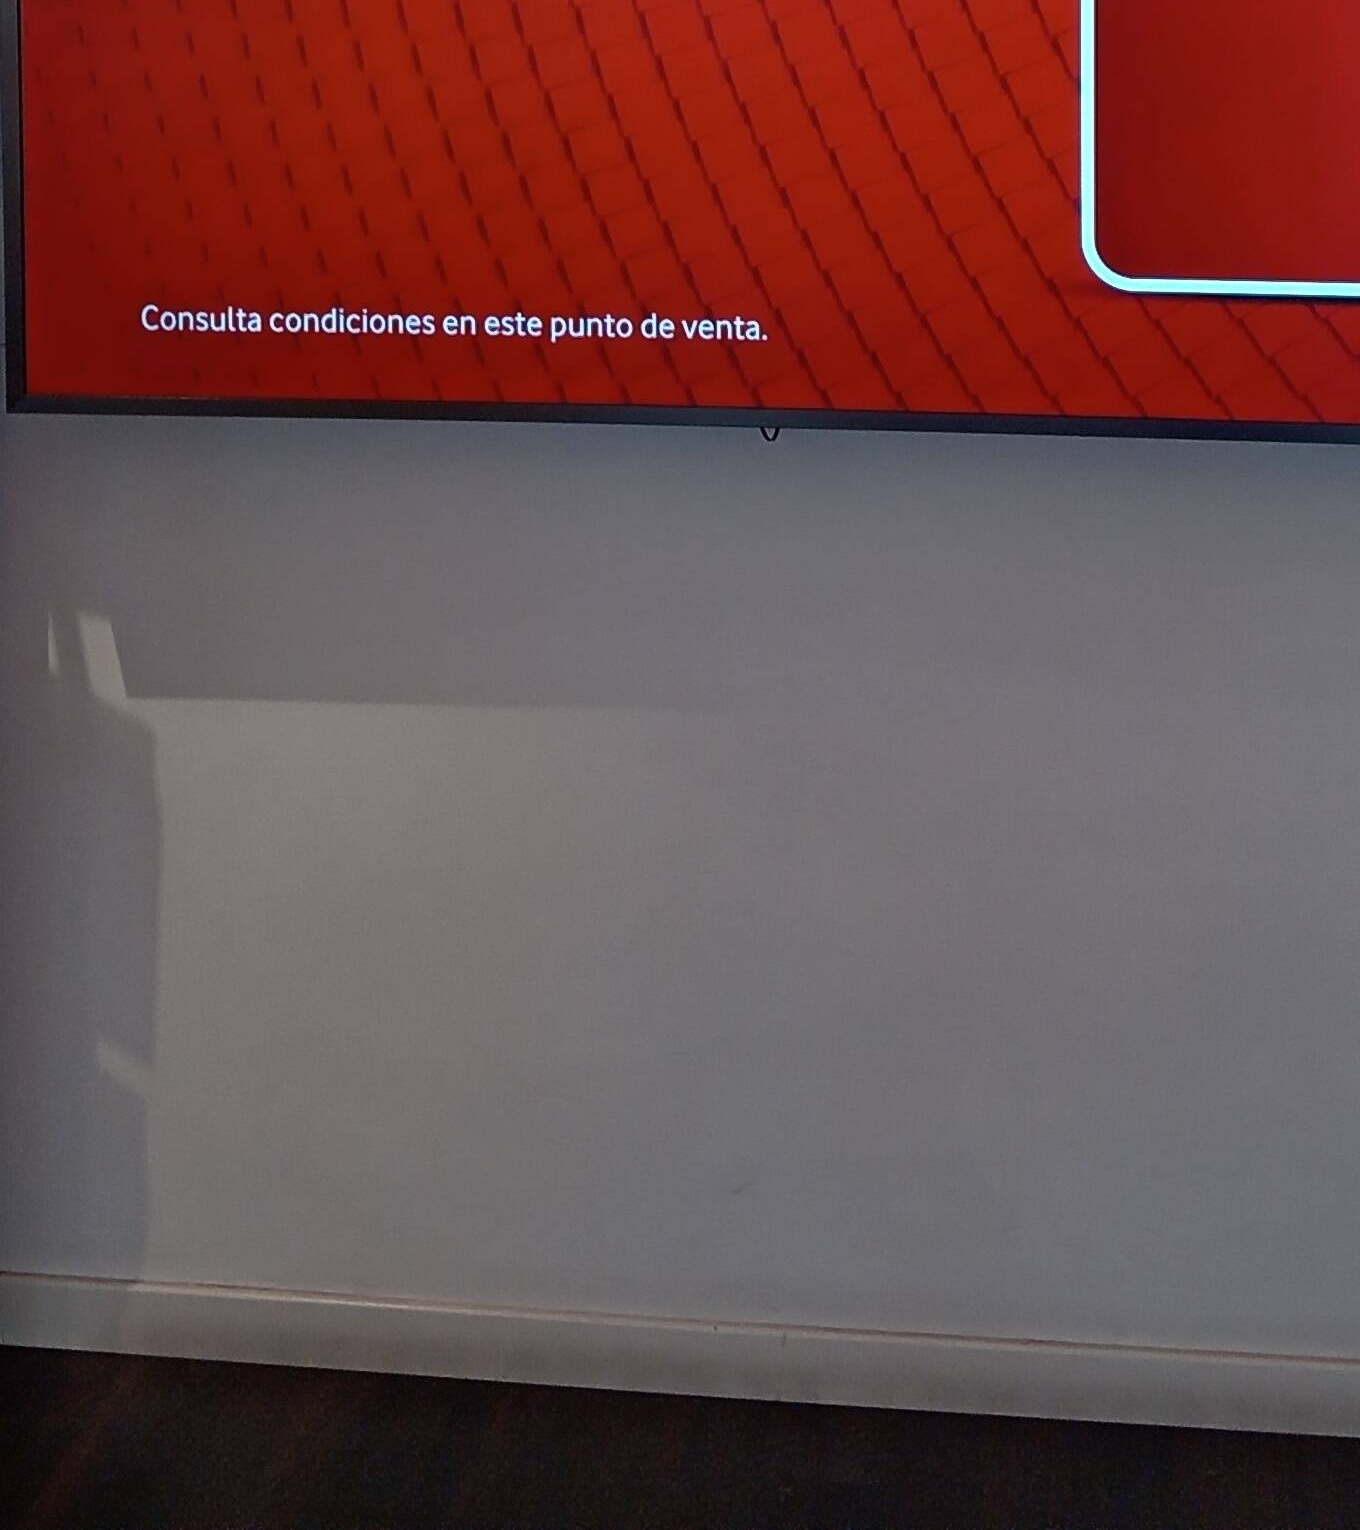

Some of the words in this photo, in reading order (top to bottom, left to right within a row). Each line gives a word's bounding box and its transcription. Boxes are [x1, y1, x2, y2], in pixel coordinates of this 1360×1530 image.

[141, 304, 262, 333] Consulta
[269, 307, 436, 335] condiciones
[442, 315, 476, 336] en
[484, 312, 543, 337] este
[550, 313, 633, 343] punto
[640, 312, 675, 339] de
[681, 316, 768, 341] venta.
